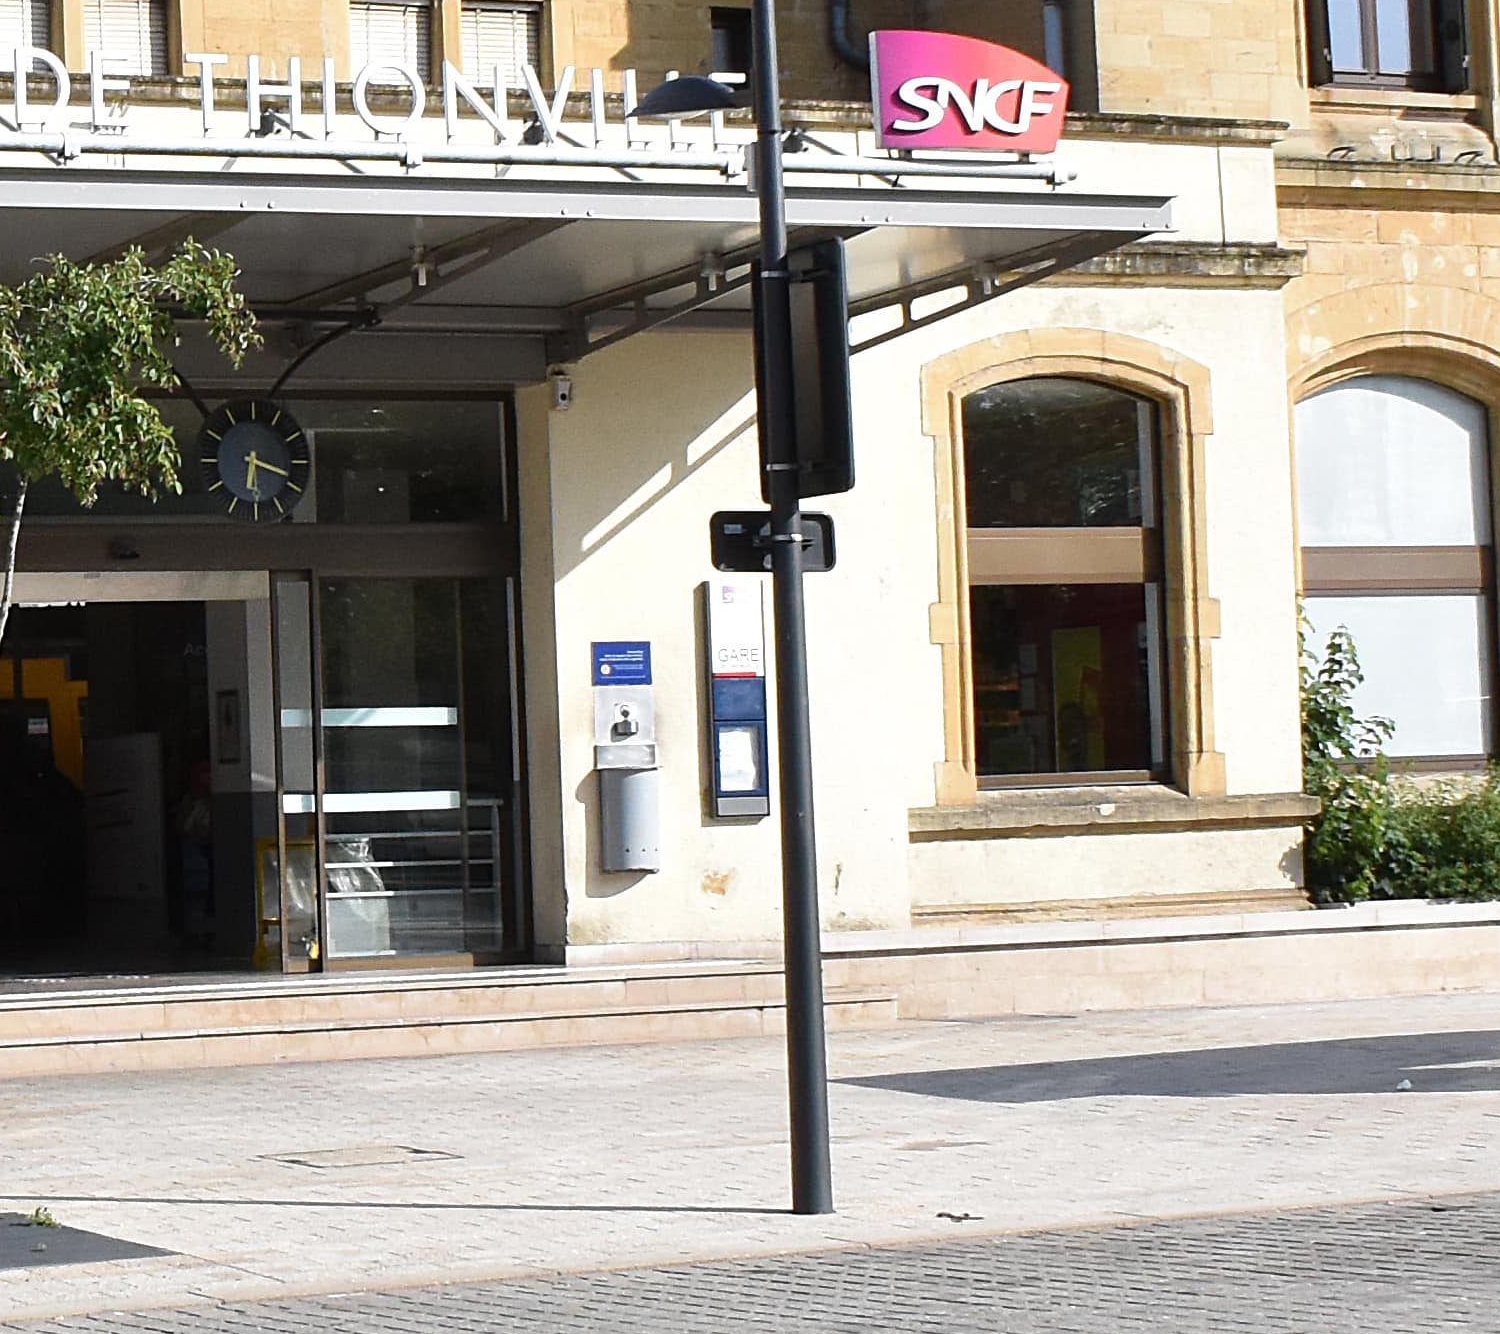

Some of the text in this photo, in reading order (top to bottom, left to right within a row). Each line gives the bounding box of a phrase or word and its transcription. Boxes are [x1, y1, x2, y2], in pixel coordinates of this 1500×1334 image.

[13, 46, 131, 128] DE
[892, 76, 1063, 135] SNCF
[718, 648, 760, 663] GARE
